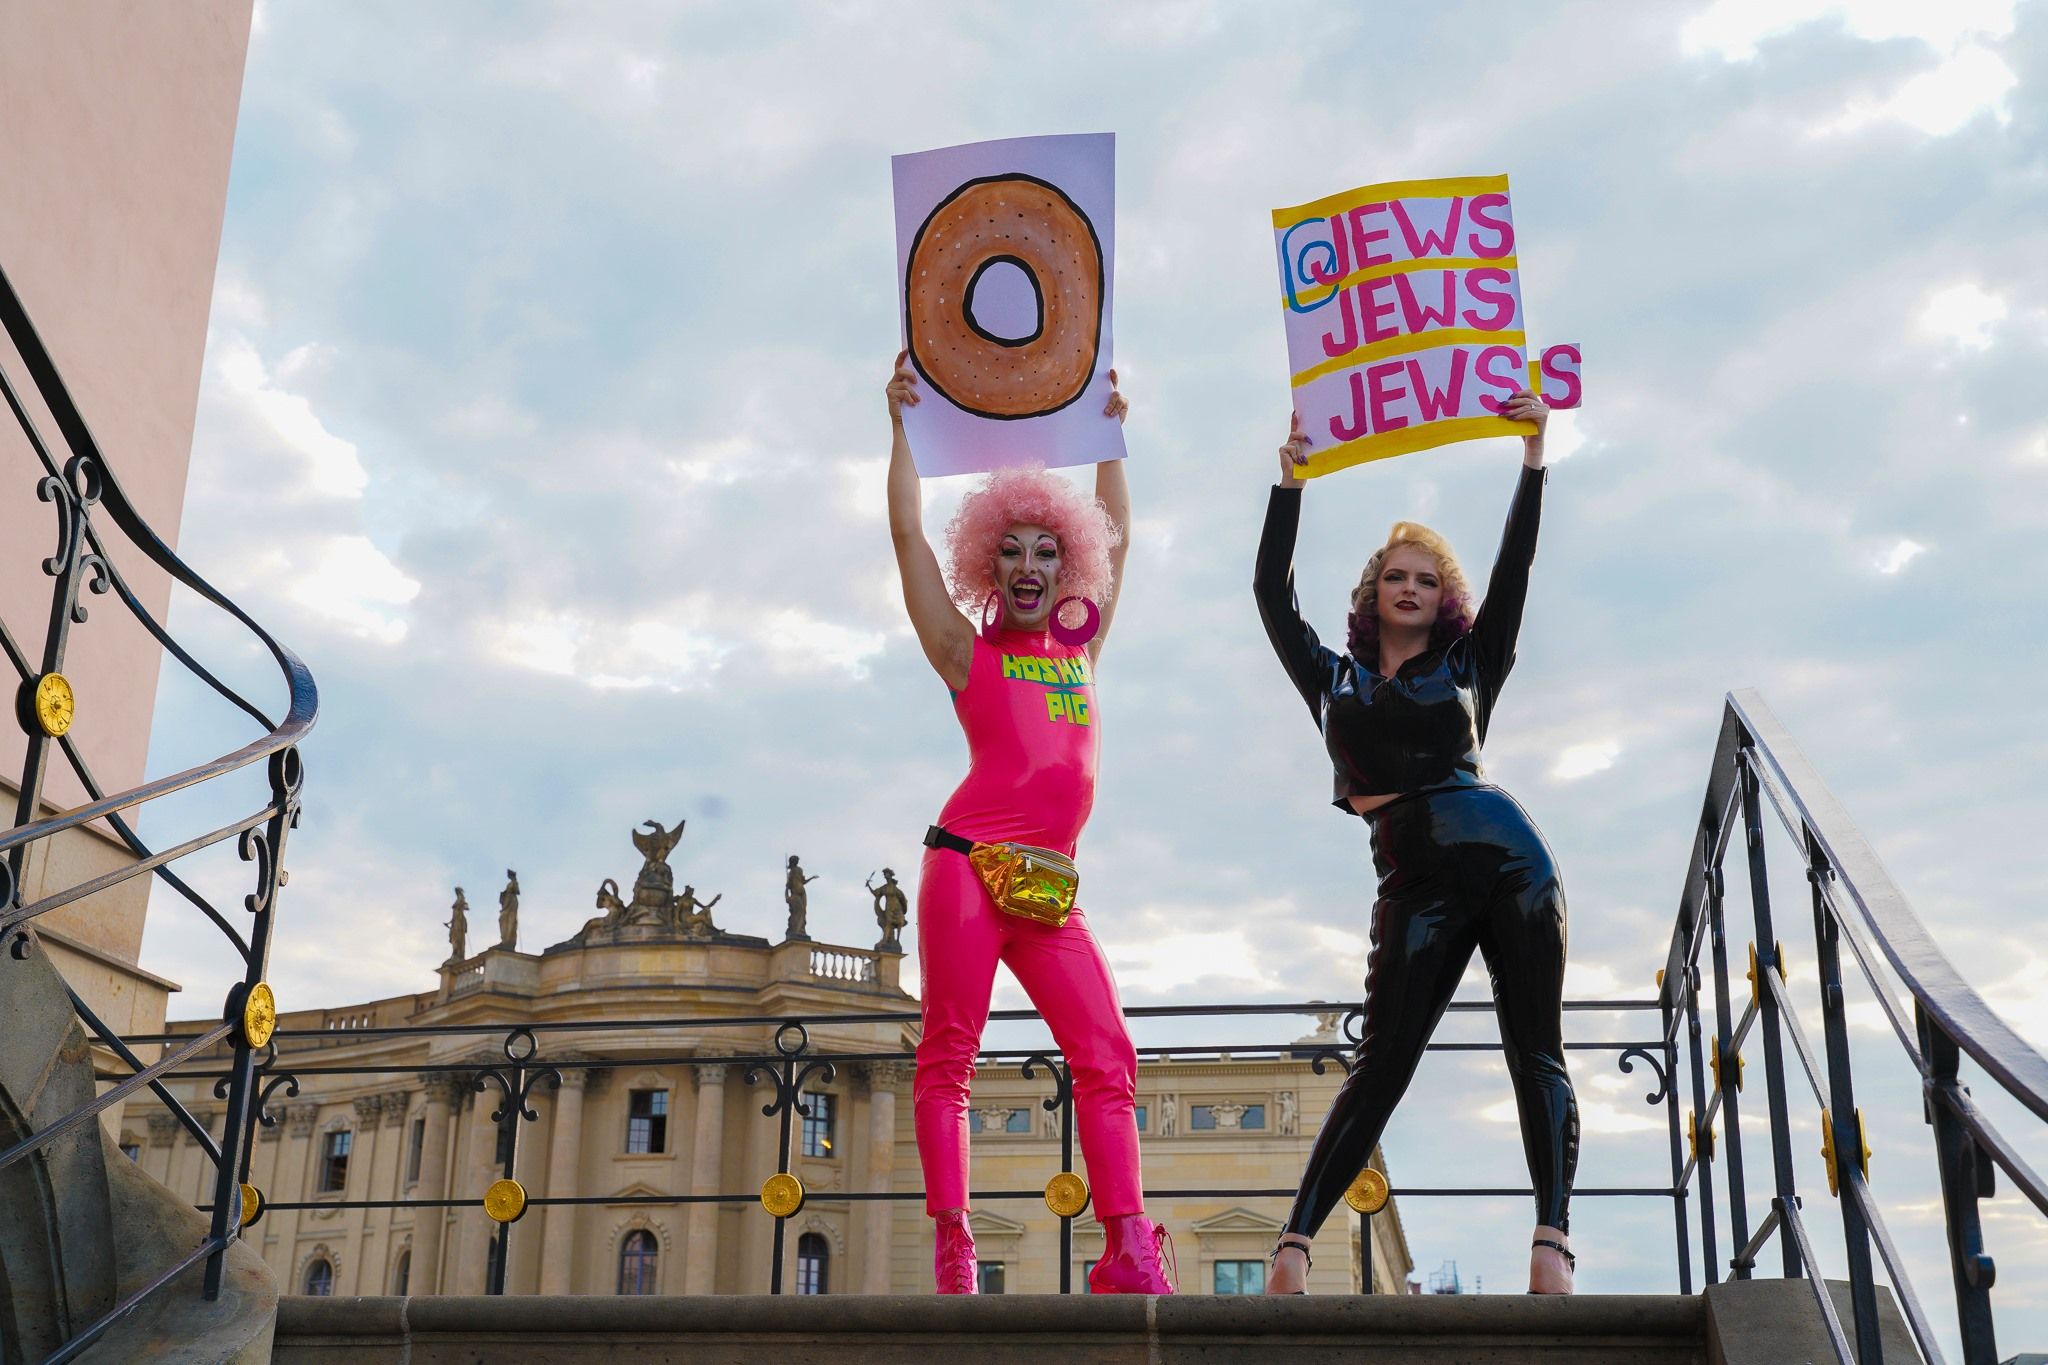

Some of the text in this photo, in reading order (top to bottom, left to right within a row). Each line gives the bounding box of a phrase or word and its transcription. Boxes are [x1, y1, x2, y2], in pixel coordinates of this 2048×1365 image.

[1322, 267, 1515, 358] JEWS
[1329, 345, 1522, 442] JEWS
[1044, 692, 1090, 726] PIG
